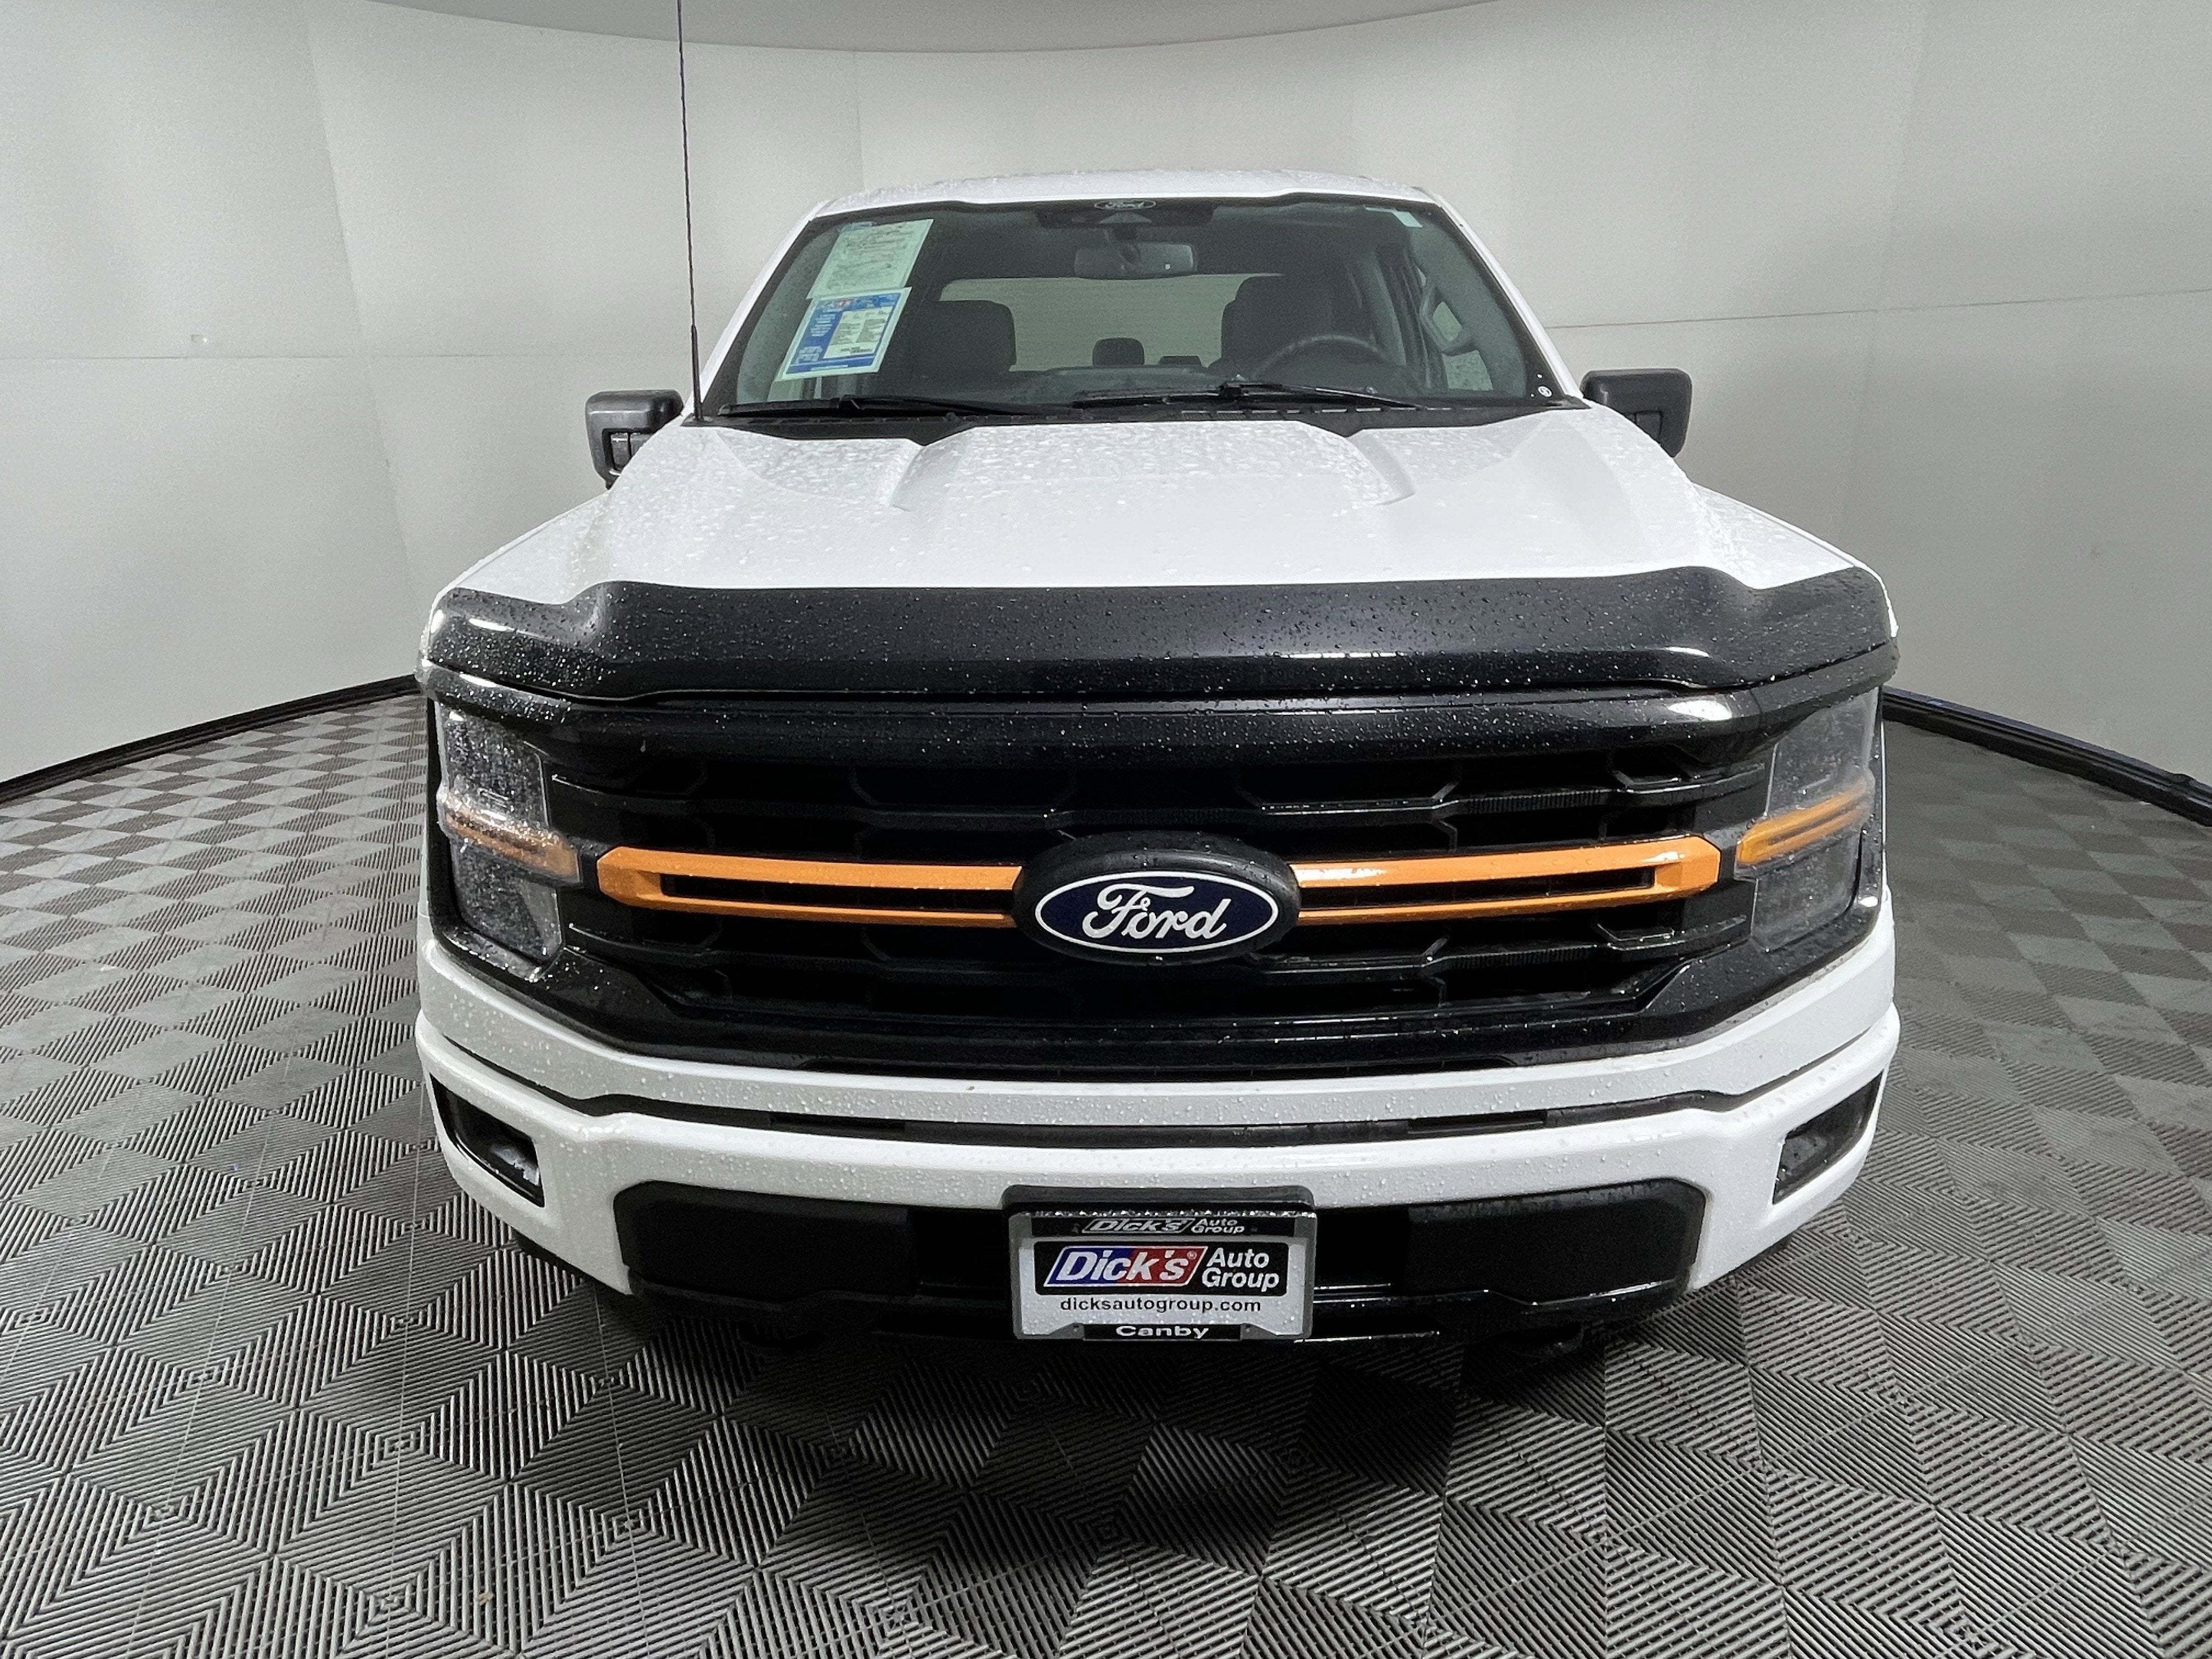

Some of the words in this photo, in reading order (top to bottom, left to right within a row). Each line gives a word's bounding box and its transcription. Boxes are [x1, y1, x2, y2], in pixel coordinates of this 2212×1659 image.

[1082, 883, 1232, 939] Ford
[1190, 1225, 1245, 1234] Group
[1193, 1218, 1238, 1226] Auto
[1056, 1250, 1189, 1281] Dick's
[1206, 1248, 1269, 1268] Auto
[1201, 1267, 1279, 1291] Group
[1060, 1297, 1261, 1313] dicksautogroup.com
[1115, 1325, 1209, 1339] Canby
